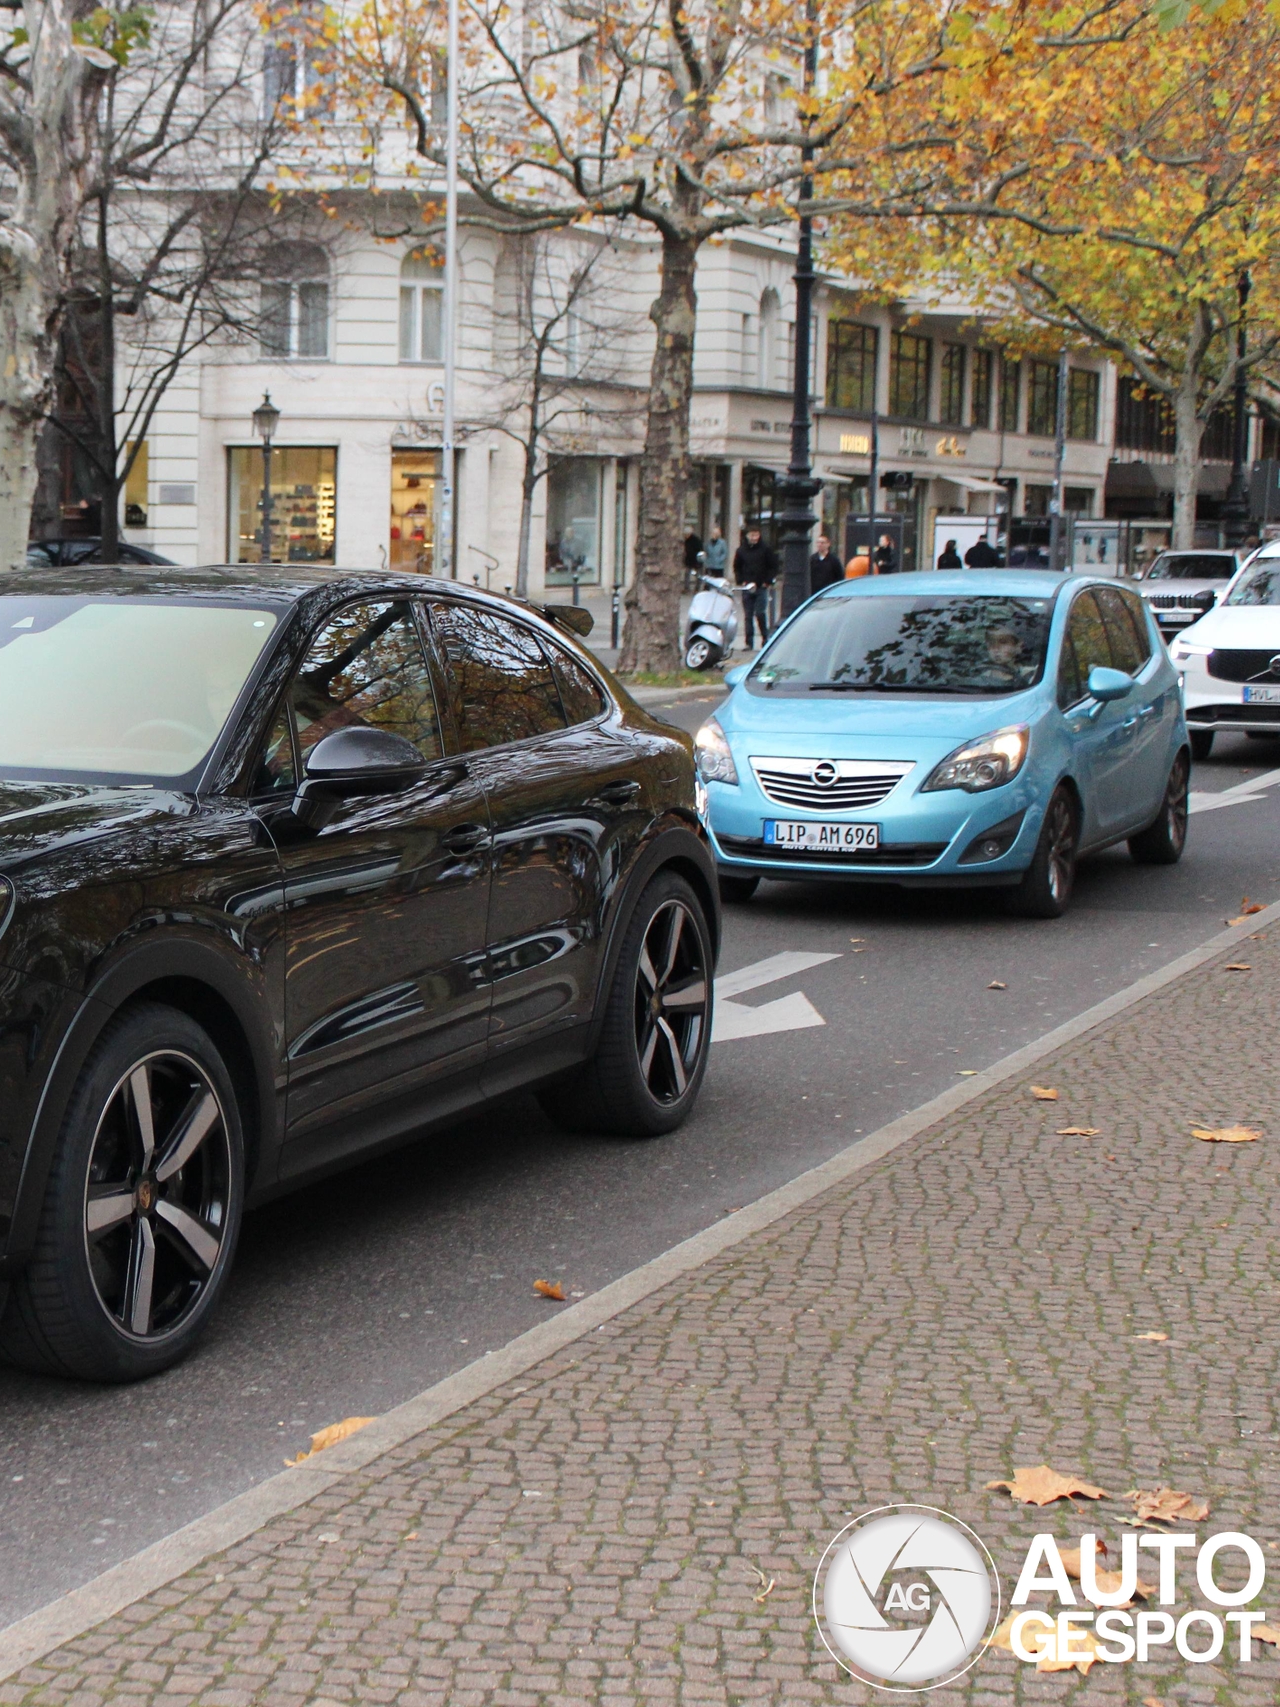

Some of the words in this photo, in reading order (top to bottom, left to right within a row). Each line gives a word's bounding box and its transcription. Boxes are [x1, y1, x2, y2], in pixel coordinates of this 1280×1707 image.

[776, 824, 806, 842] LIP
[819, 826, 840, 844] AM
[844, 826, 875, 846] 696
